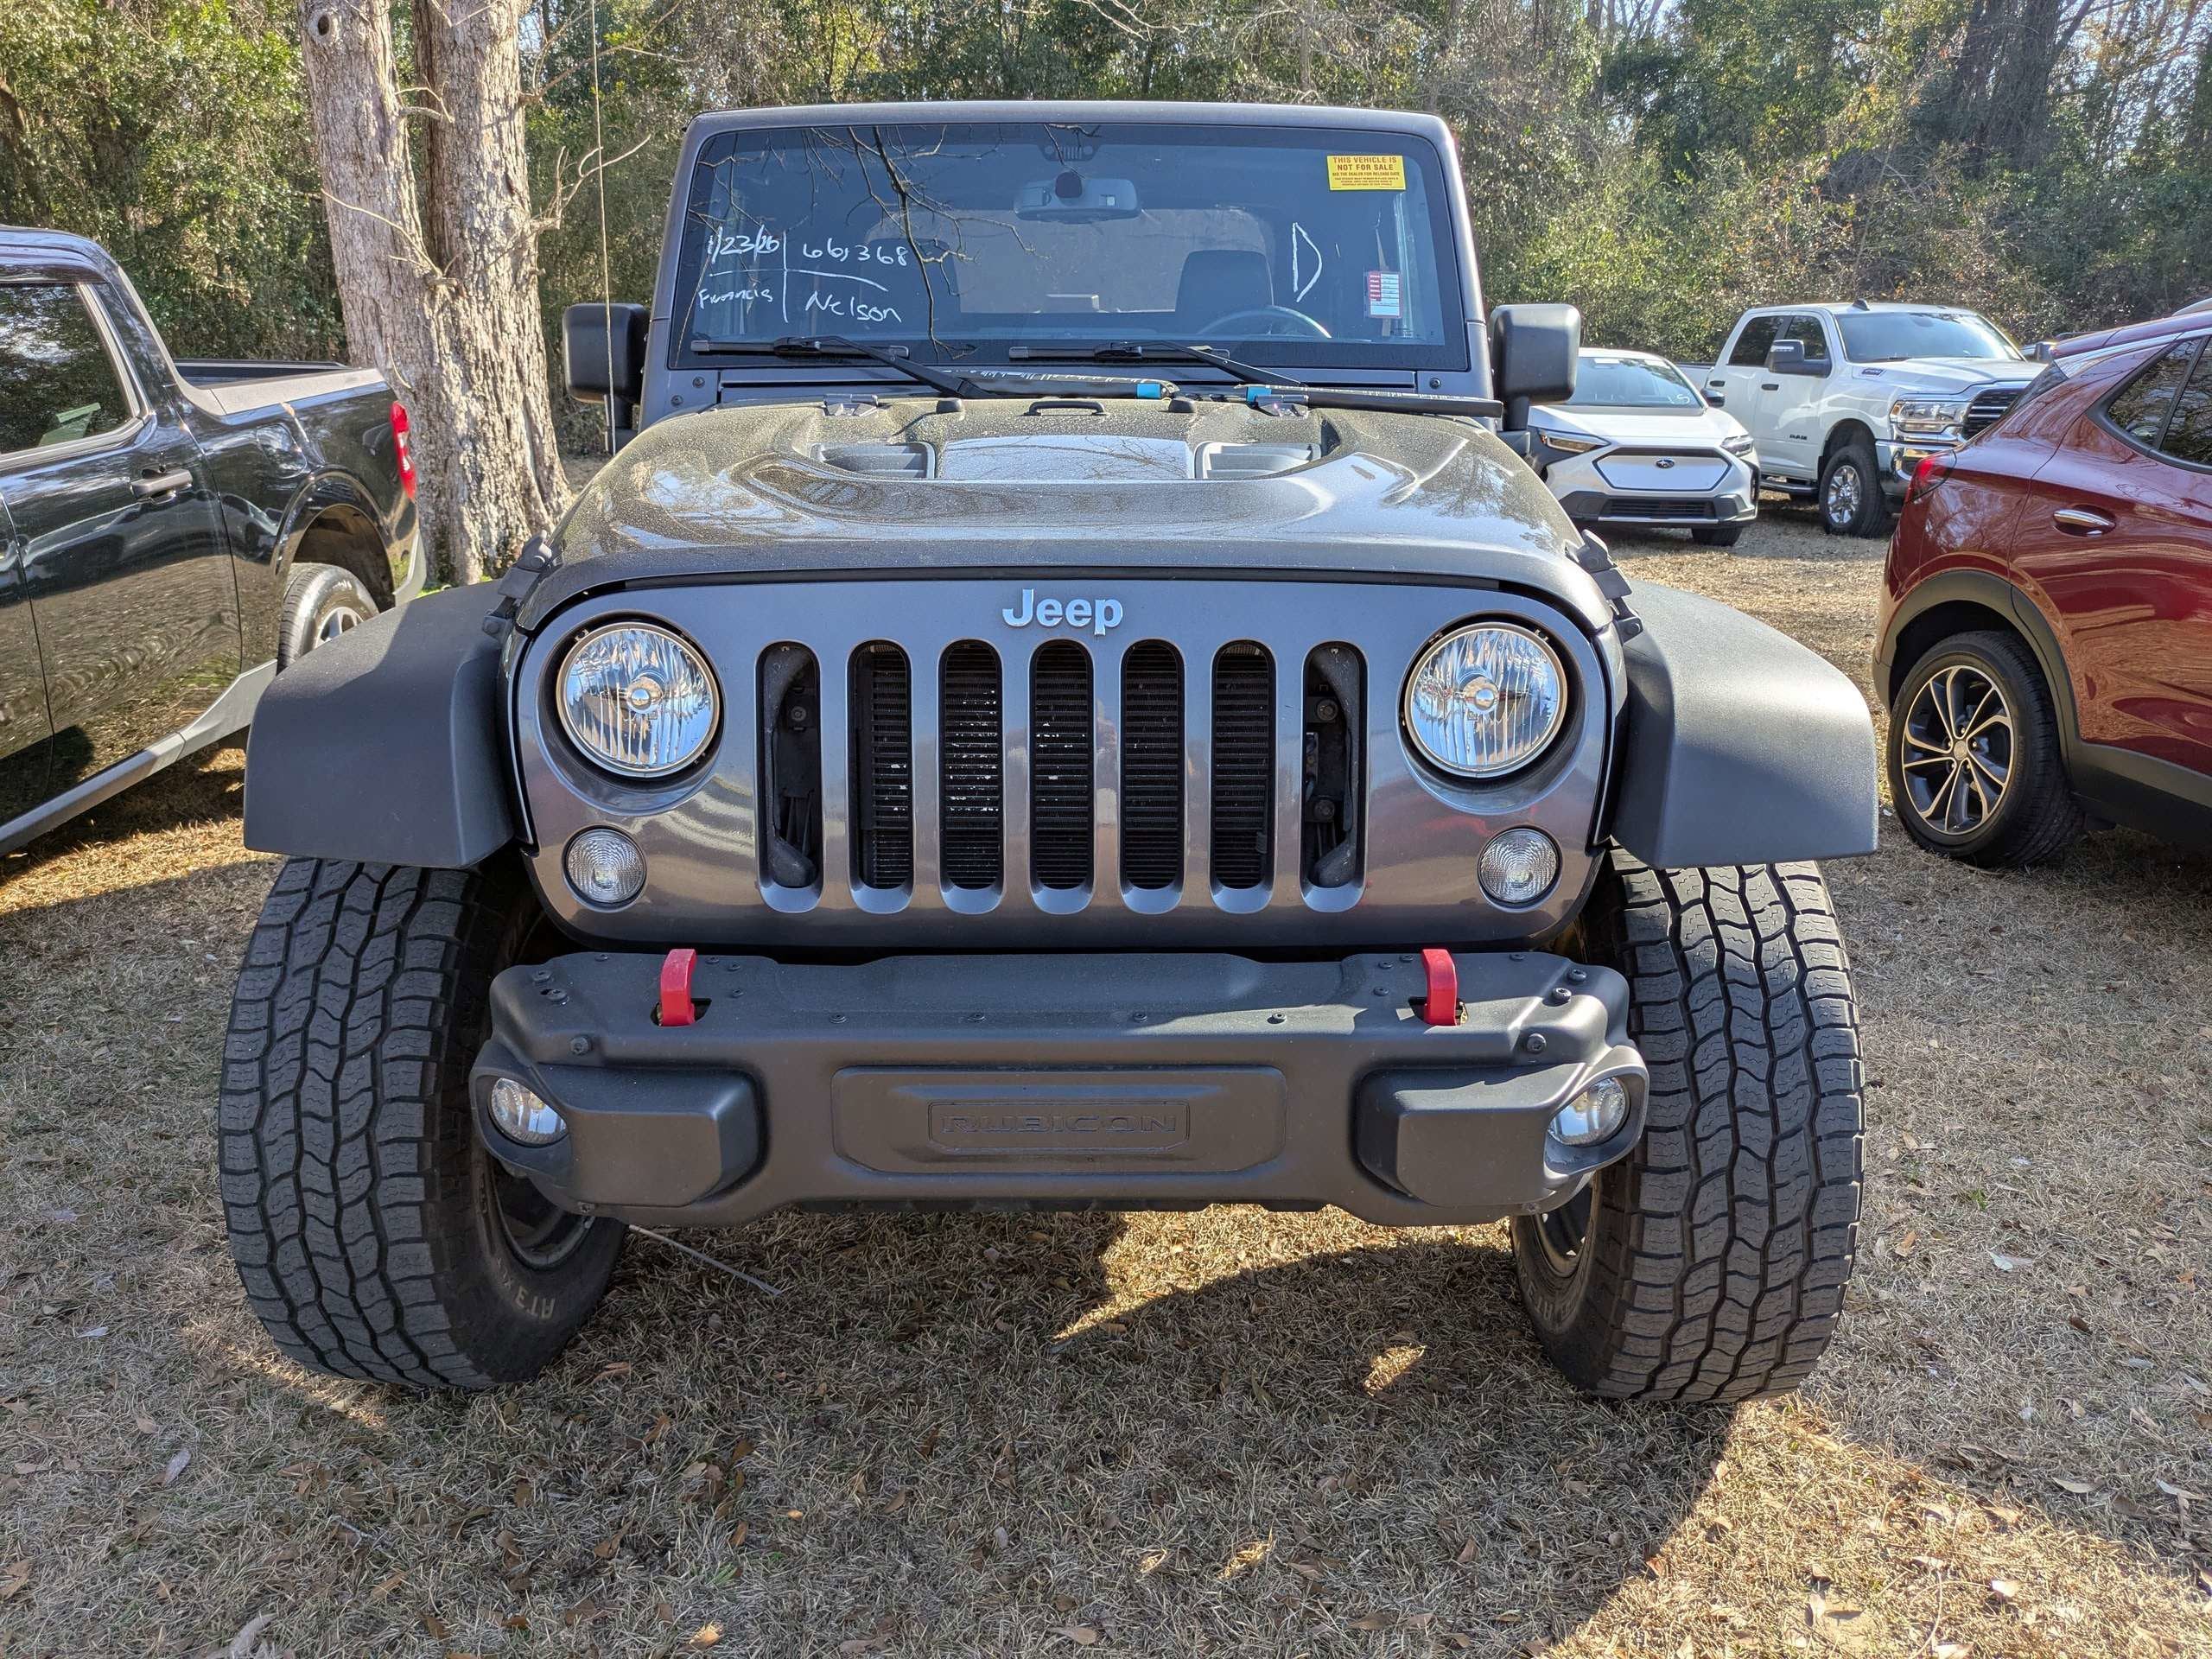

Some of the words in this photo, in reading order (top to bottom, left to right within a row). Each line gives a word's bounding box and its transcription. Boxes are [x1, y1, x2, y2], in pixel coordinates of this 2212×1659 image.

[1292, 222, 1323, 302] D
[805, 291, 902, 323] Nelson
[1001, 588, 1123, 636] Jeep
[940, 1114, 1177, 1134] RUBICON
